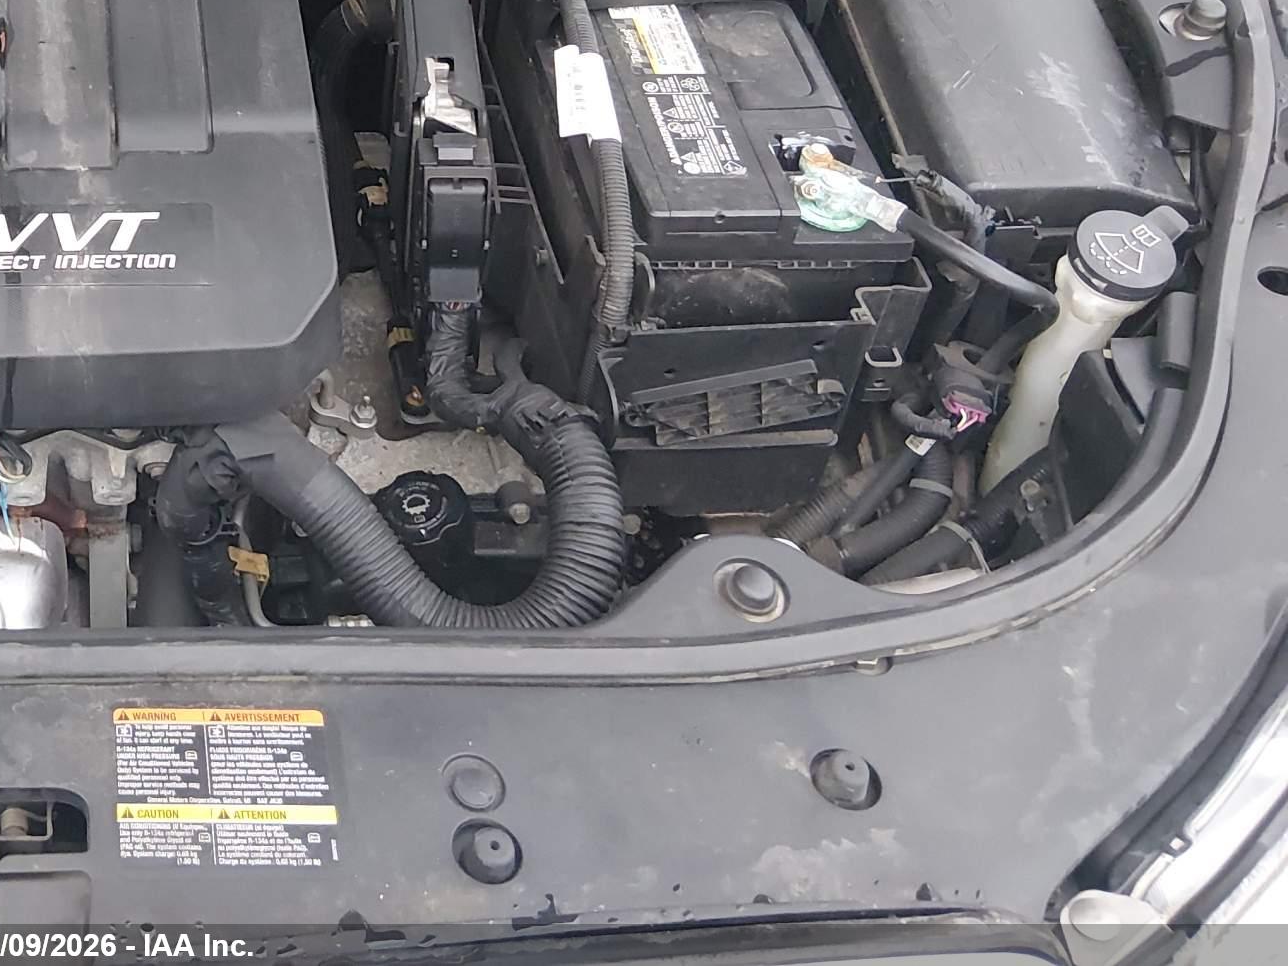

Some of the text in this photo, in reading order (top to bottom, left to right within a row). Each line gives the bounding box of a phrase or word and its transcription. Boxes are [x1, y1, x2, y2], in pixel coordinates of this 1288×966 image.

[647, 96, 677, 159] DANGER/POISON
[53, 254, 176, 270] INJECTION
[133, 713, 177, 721] WARNING
[224, 714, 300, 722] AVERTISSEMENT
[137, 810, 179, 819] CAUTION
[234, 810, 287, 819] ATTENTION
